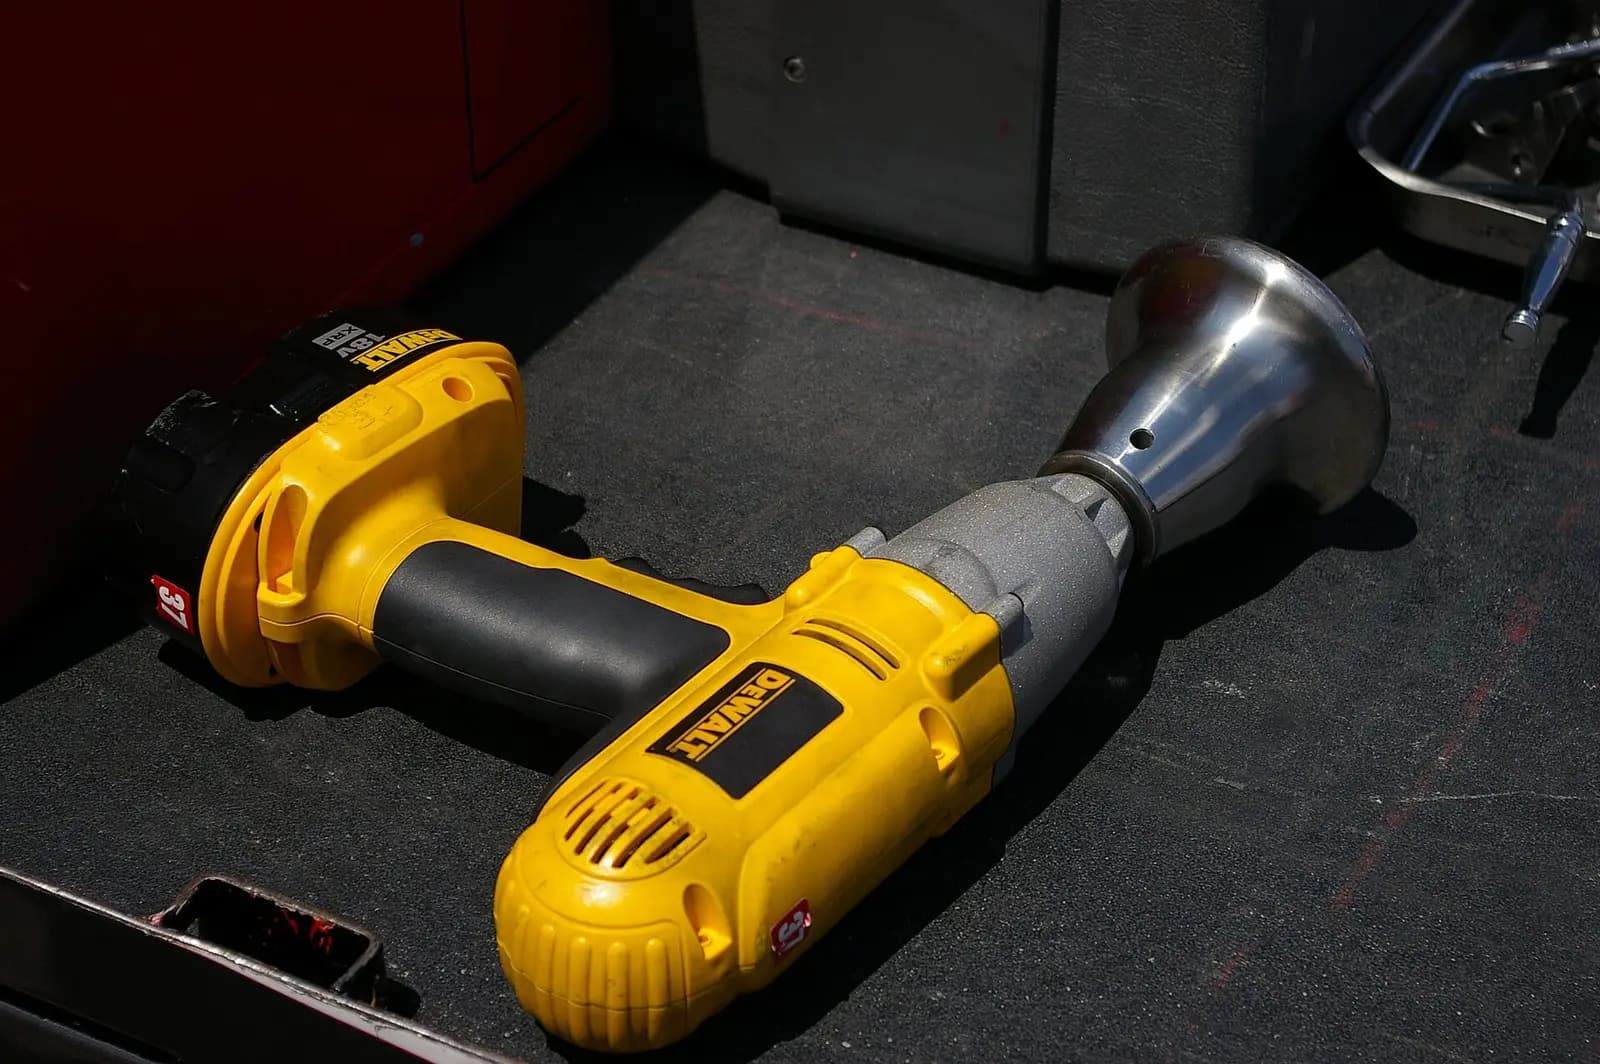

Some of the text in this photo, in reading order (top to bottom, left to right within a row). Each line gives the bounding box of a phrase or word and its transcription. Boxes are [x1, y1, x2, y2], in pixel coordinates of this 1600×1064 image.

[322, 325, 357, 346] XRP
[336, 333, 387, 358] 18V
[356, 329, 461, 371] DEWALT
[158, 585, 189, 629] 37
[672, 668, 792, 761] DEWALT
